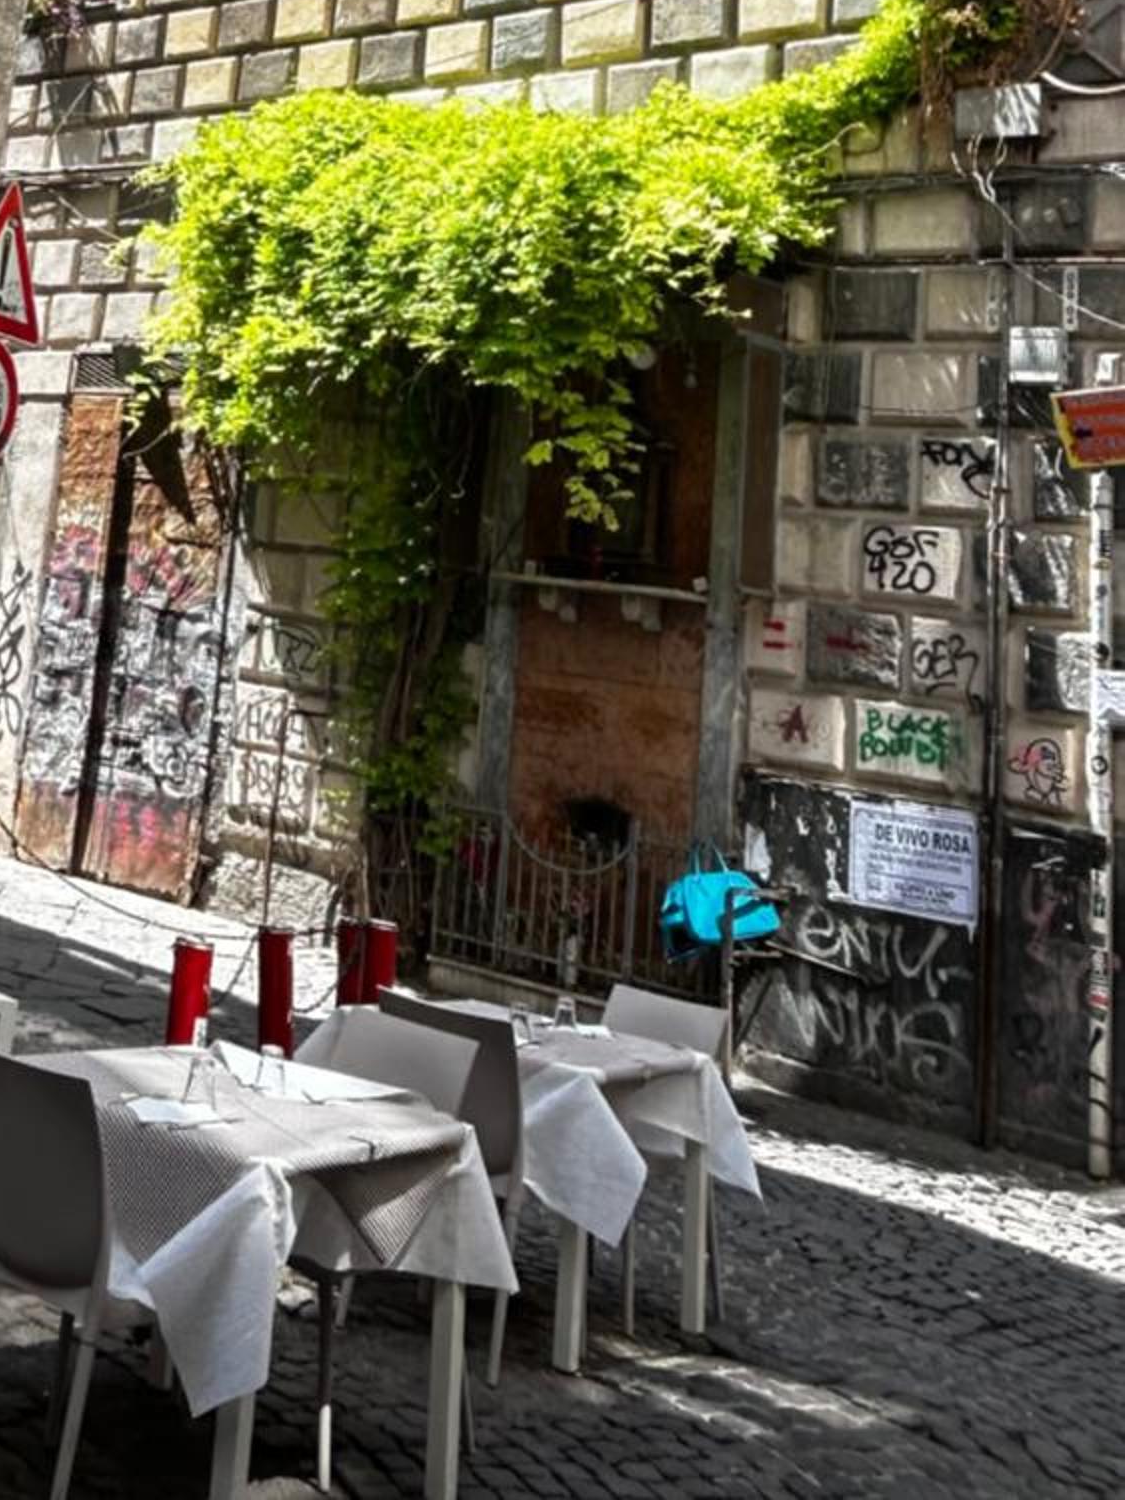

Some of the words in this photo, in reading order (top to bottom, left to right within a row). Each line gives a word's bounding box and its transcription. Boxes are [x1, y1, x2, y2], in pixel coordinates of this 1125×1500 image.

[867, 708, 948, 737] BLACK
[876, 823, 893, 842] DE
[897, 826, 929, 848] VIVO
[932, 832, 971, 853] ROSA
